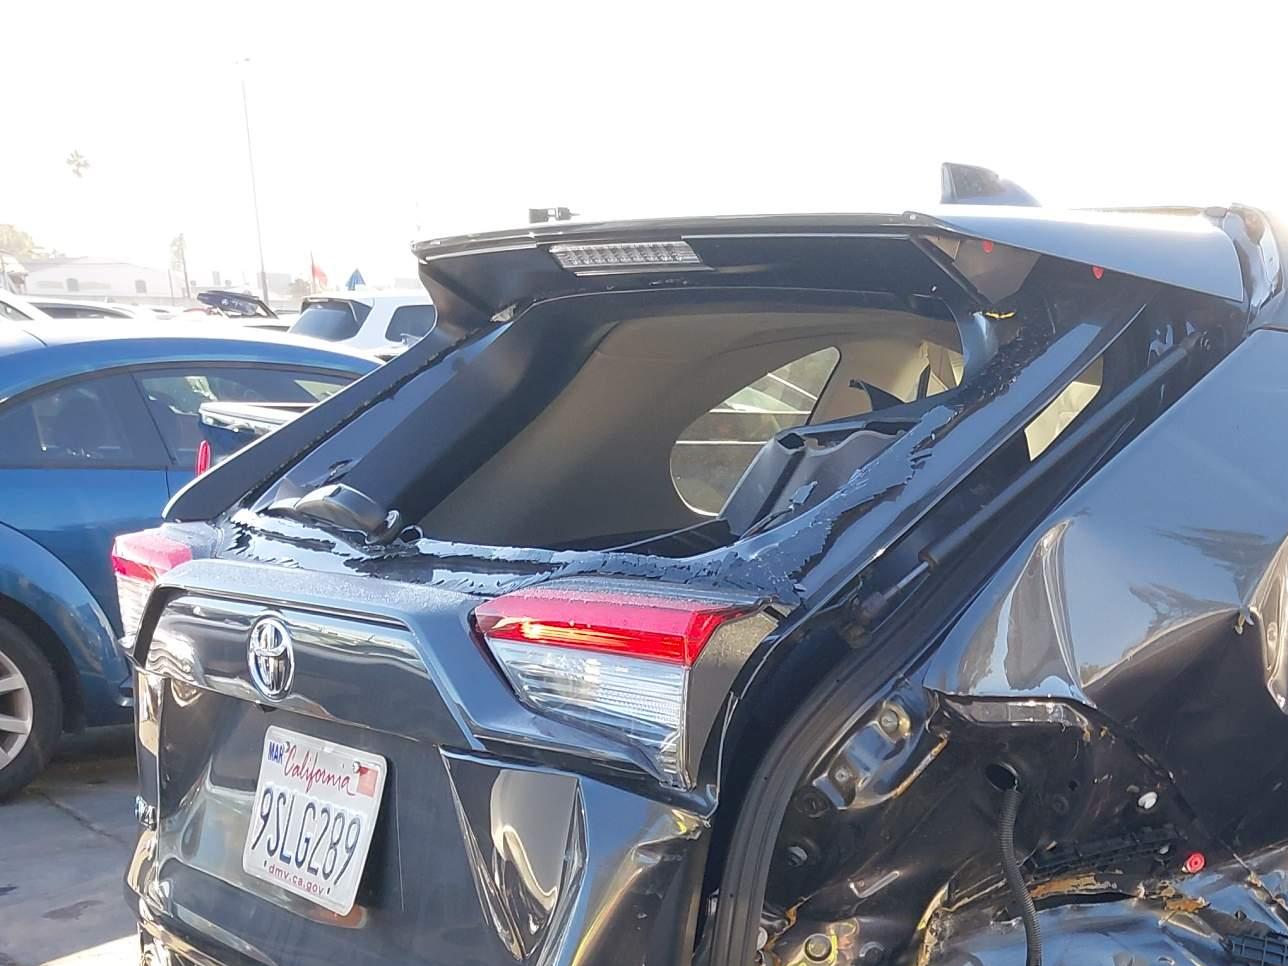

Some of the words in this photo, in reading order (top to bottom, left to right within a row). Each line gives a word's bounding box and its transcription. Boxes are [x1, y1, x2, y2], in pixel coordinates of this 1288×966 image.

[268, 741, 284, 765] MAR
[284, 744, 356, 796] California
[251, 786, 362, 886] 9SLG289
[268, 866, 325, 895] dmv.ca.gov
